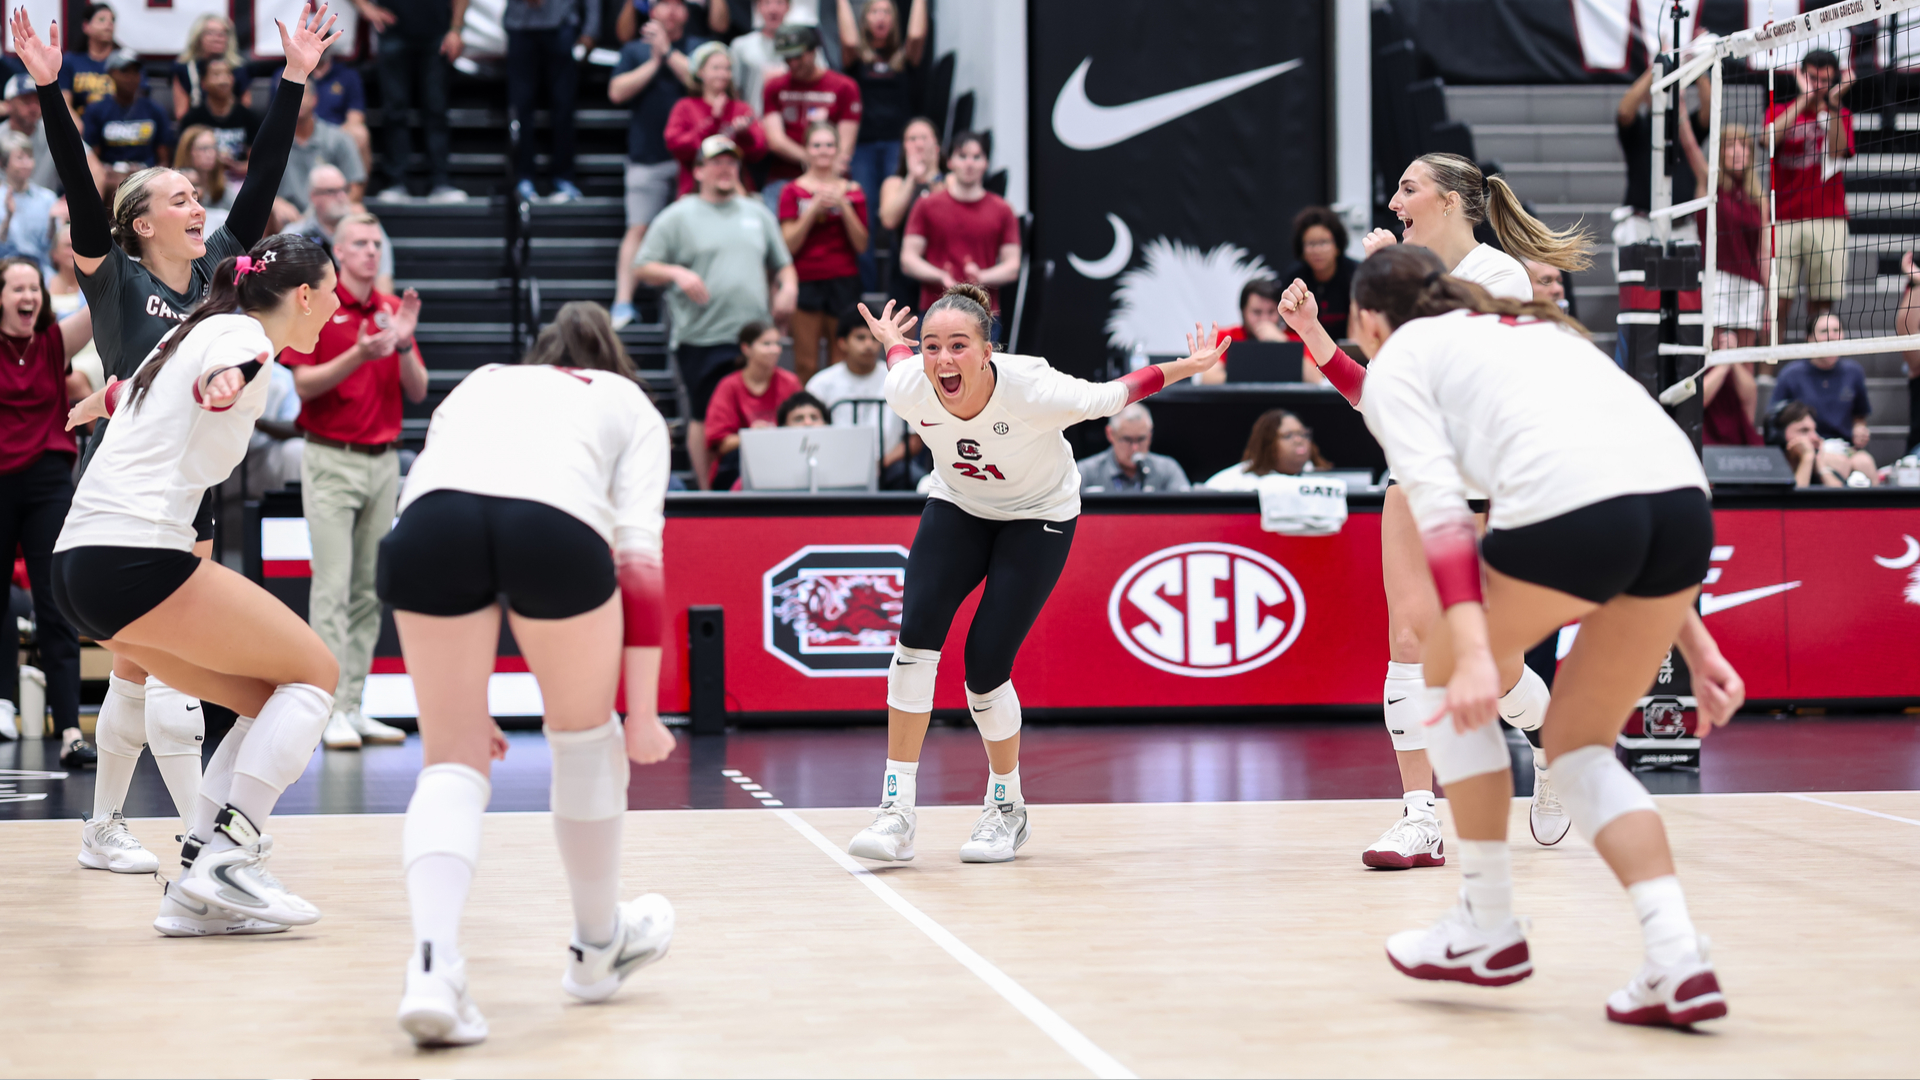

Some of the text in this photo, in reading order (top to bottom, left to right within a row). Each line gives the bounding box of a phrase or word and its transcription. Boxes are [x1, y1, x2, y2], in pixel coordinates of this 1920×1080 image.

[994, 422, 1009, 435] SEC
[952, 461, 1006, 481] 21
[1127, 552, 1287, 667] SEC
